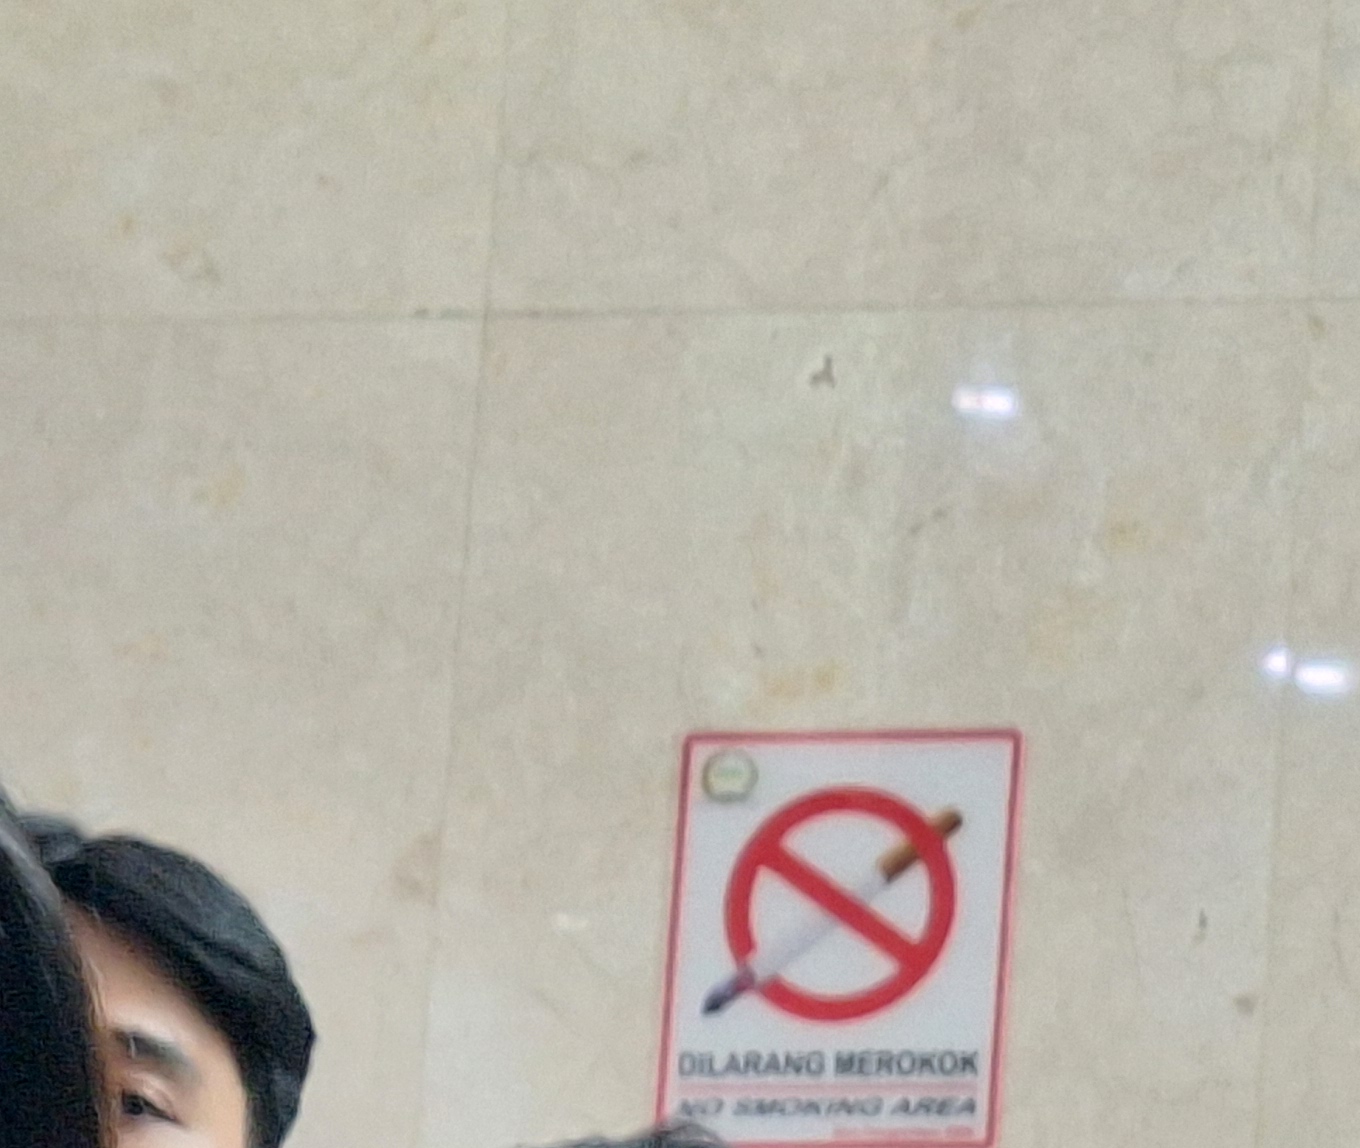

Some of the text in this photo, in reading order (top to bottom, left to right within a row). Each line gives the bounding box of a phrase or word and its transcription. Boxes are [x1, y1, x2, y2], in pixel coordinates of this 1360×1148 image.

[679, 1050, 978, 1077] DILARANG MEROKOK
[679, 1097, 976, 1117] NO SMOKING AREA
